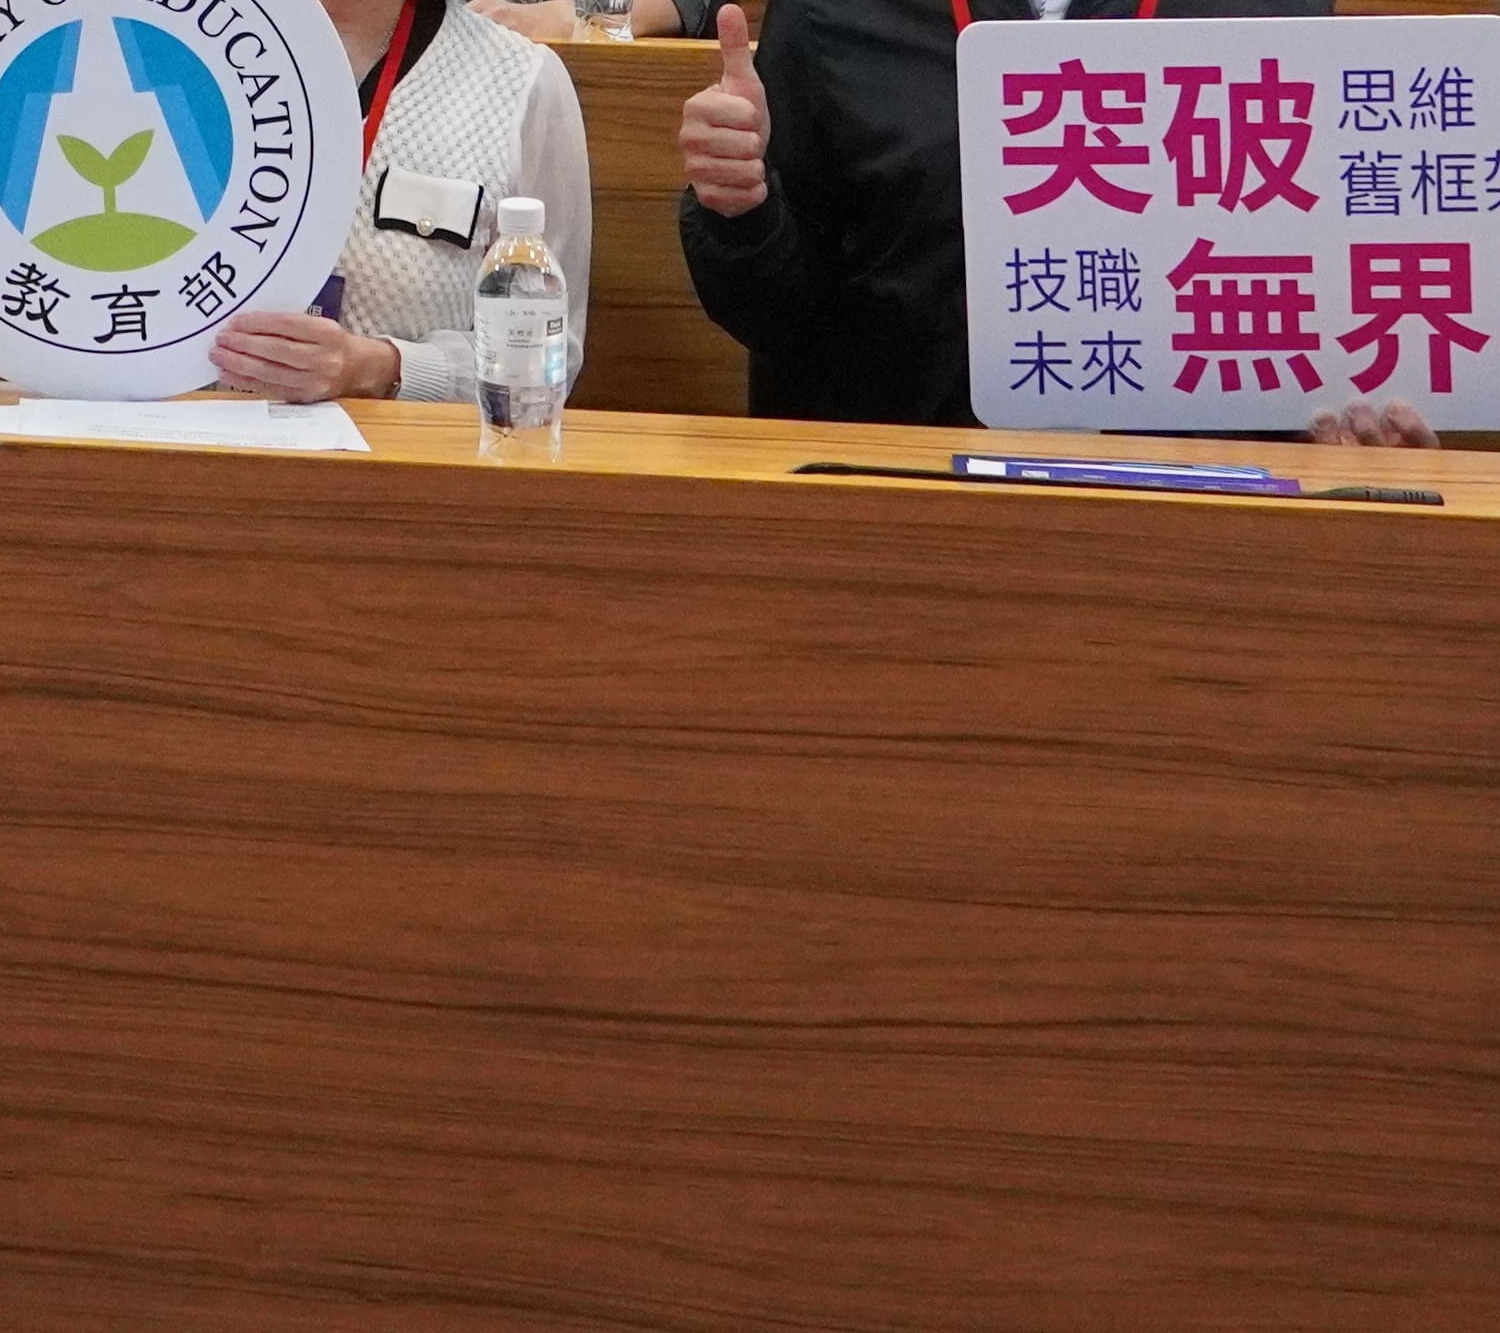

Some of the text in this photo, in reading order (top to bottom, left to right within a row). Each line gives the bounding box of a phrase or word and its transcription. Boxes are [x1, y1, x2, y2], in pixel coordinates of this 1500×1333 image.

[1337, 65, 1476, 132] 思維
[1001, 57, 1320, 215] 突破
[1, 250, 237, 343] 教育部
[1005, 247, 1142, 315] 技職
[1009, 329, 1145, 396] 未來
